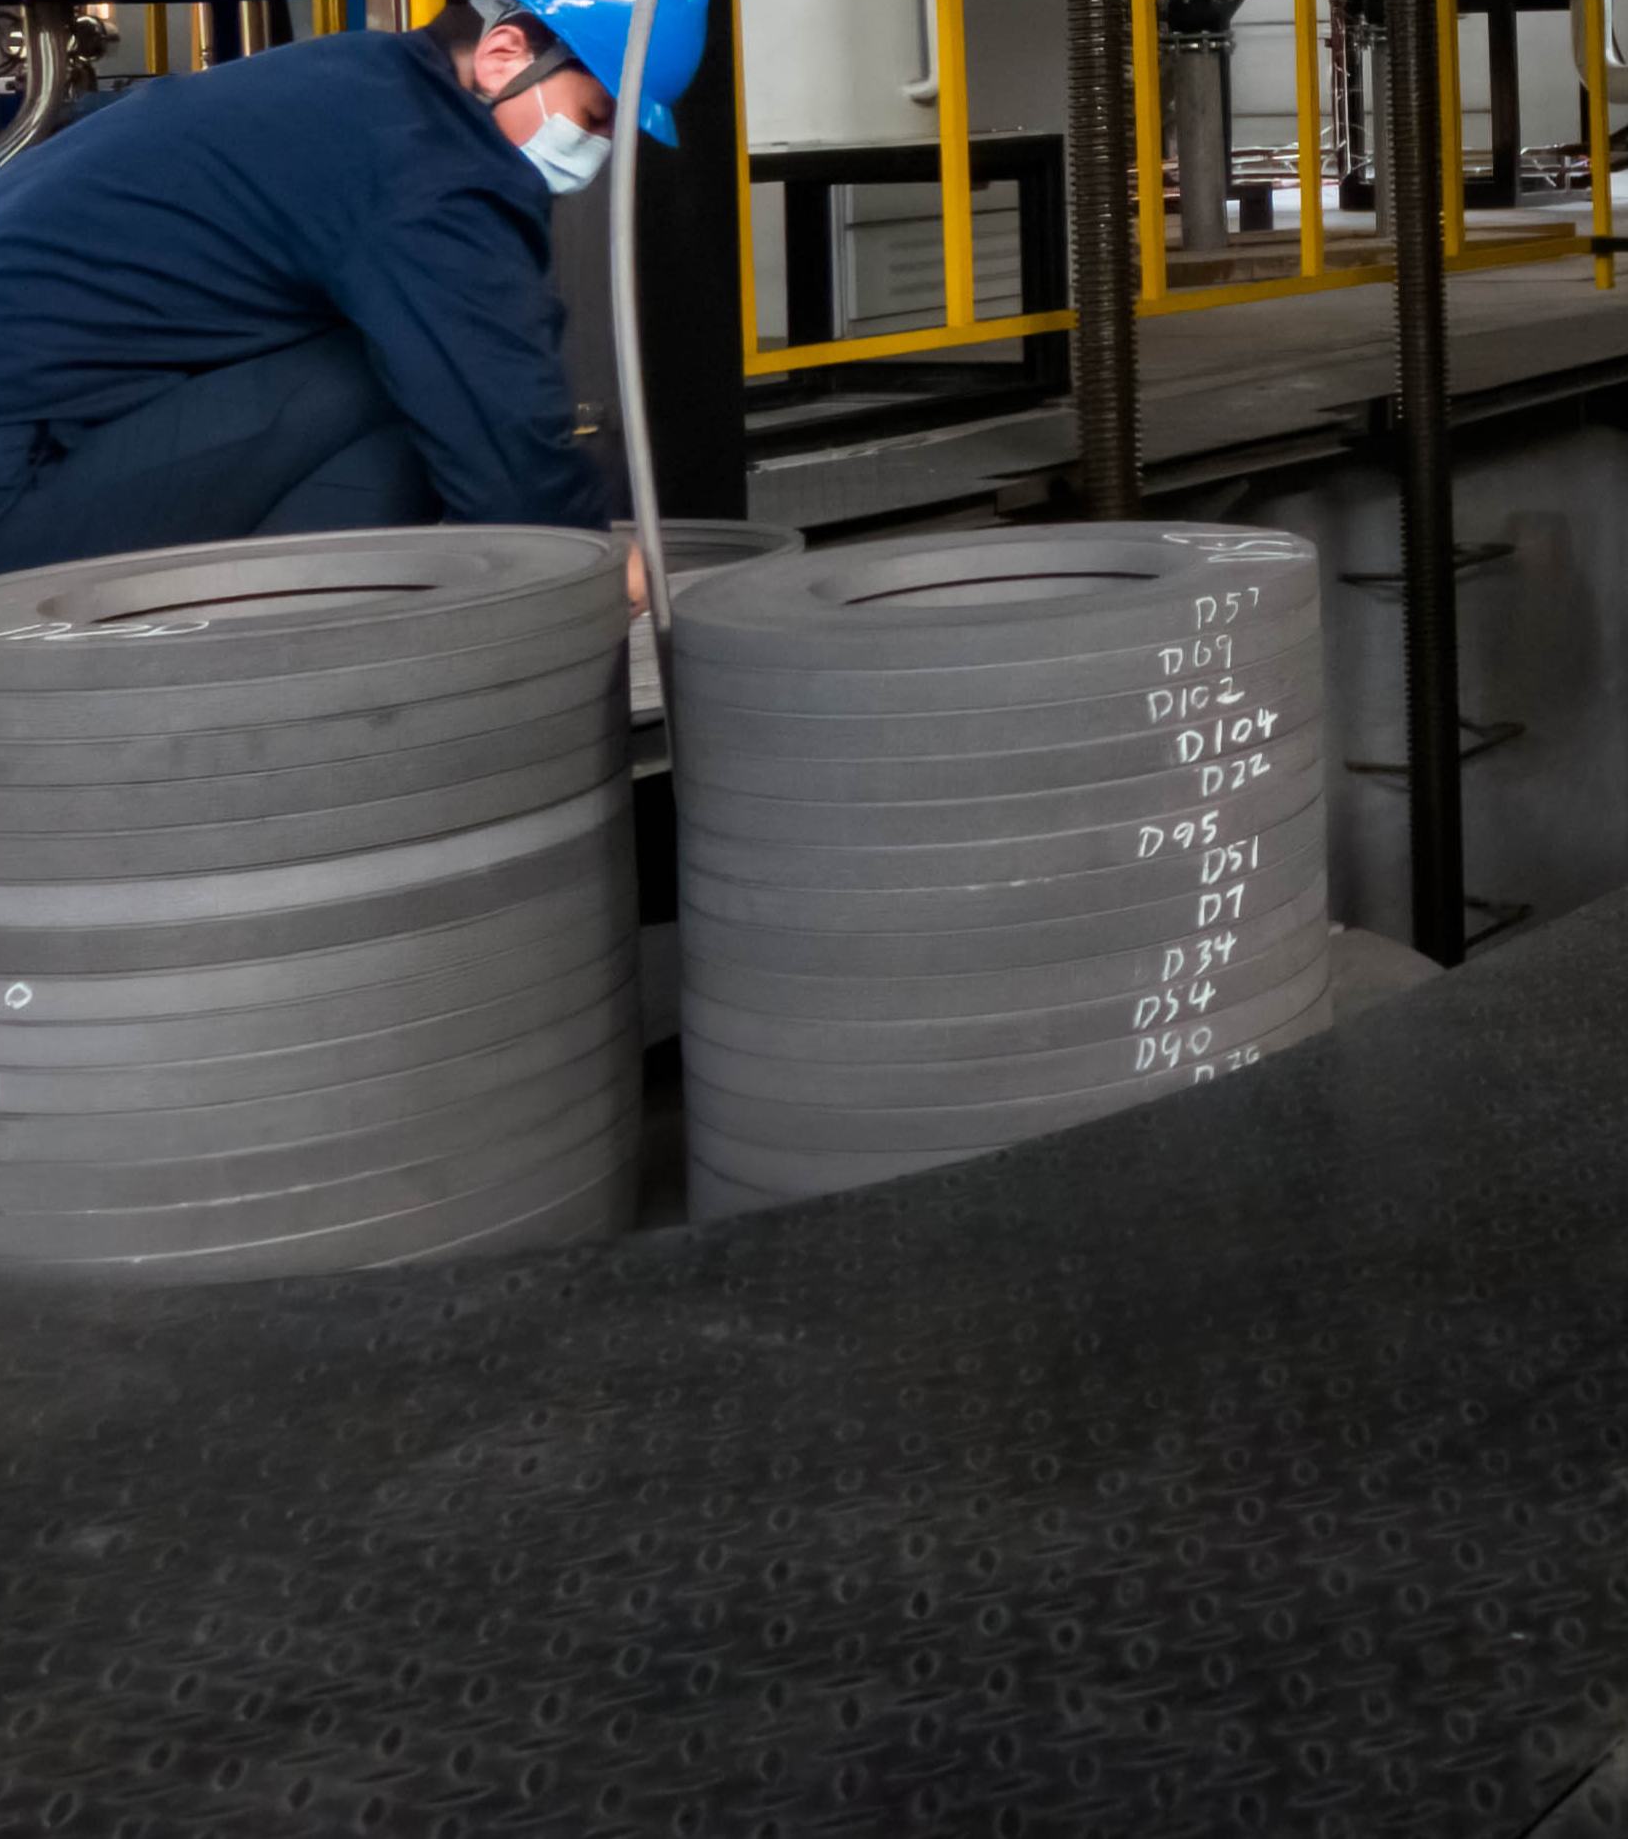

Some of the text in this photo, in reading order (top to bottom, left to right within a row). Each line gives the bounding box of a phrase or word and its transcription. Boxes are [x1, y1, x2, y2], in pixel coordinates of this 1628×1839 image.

[1157, 634, 1233, 676] D69
[1147, 676, 1246, 724] D102
[1176, 707, 1278, 763] D104
[1201, 752, 1271, 797] D22
[1137, 809, 1220, 858] D95
[1201, 835, 1260, 885] D51
[1197, 882, 1246, 928] D7
[1161, 930, 1238, 983] D34
[1132, 980, 1218, 1030] D54
